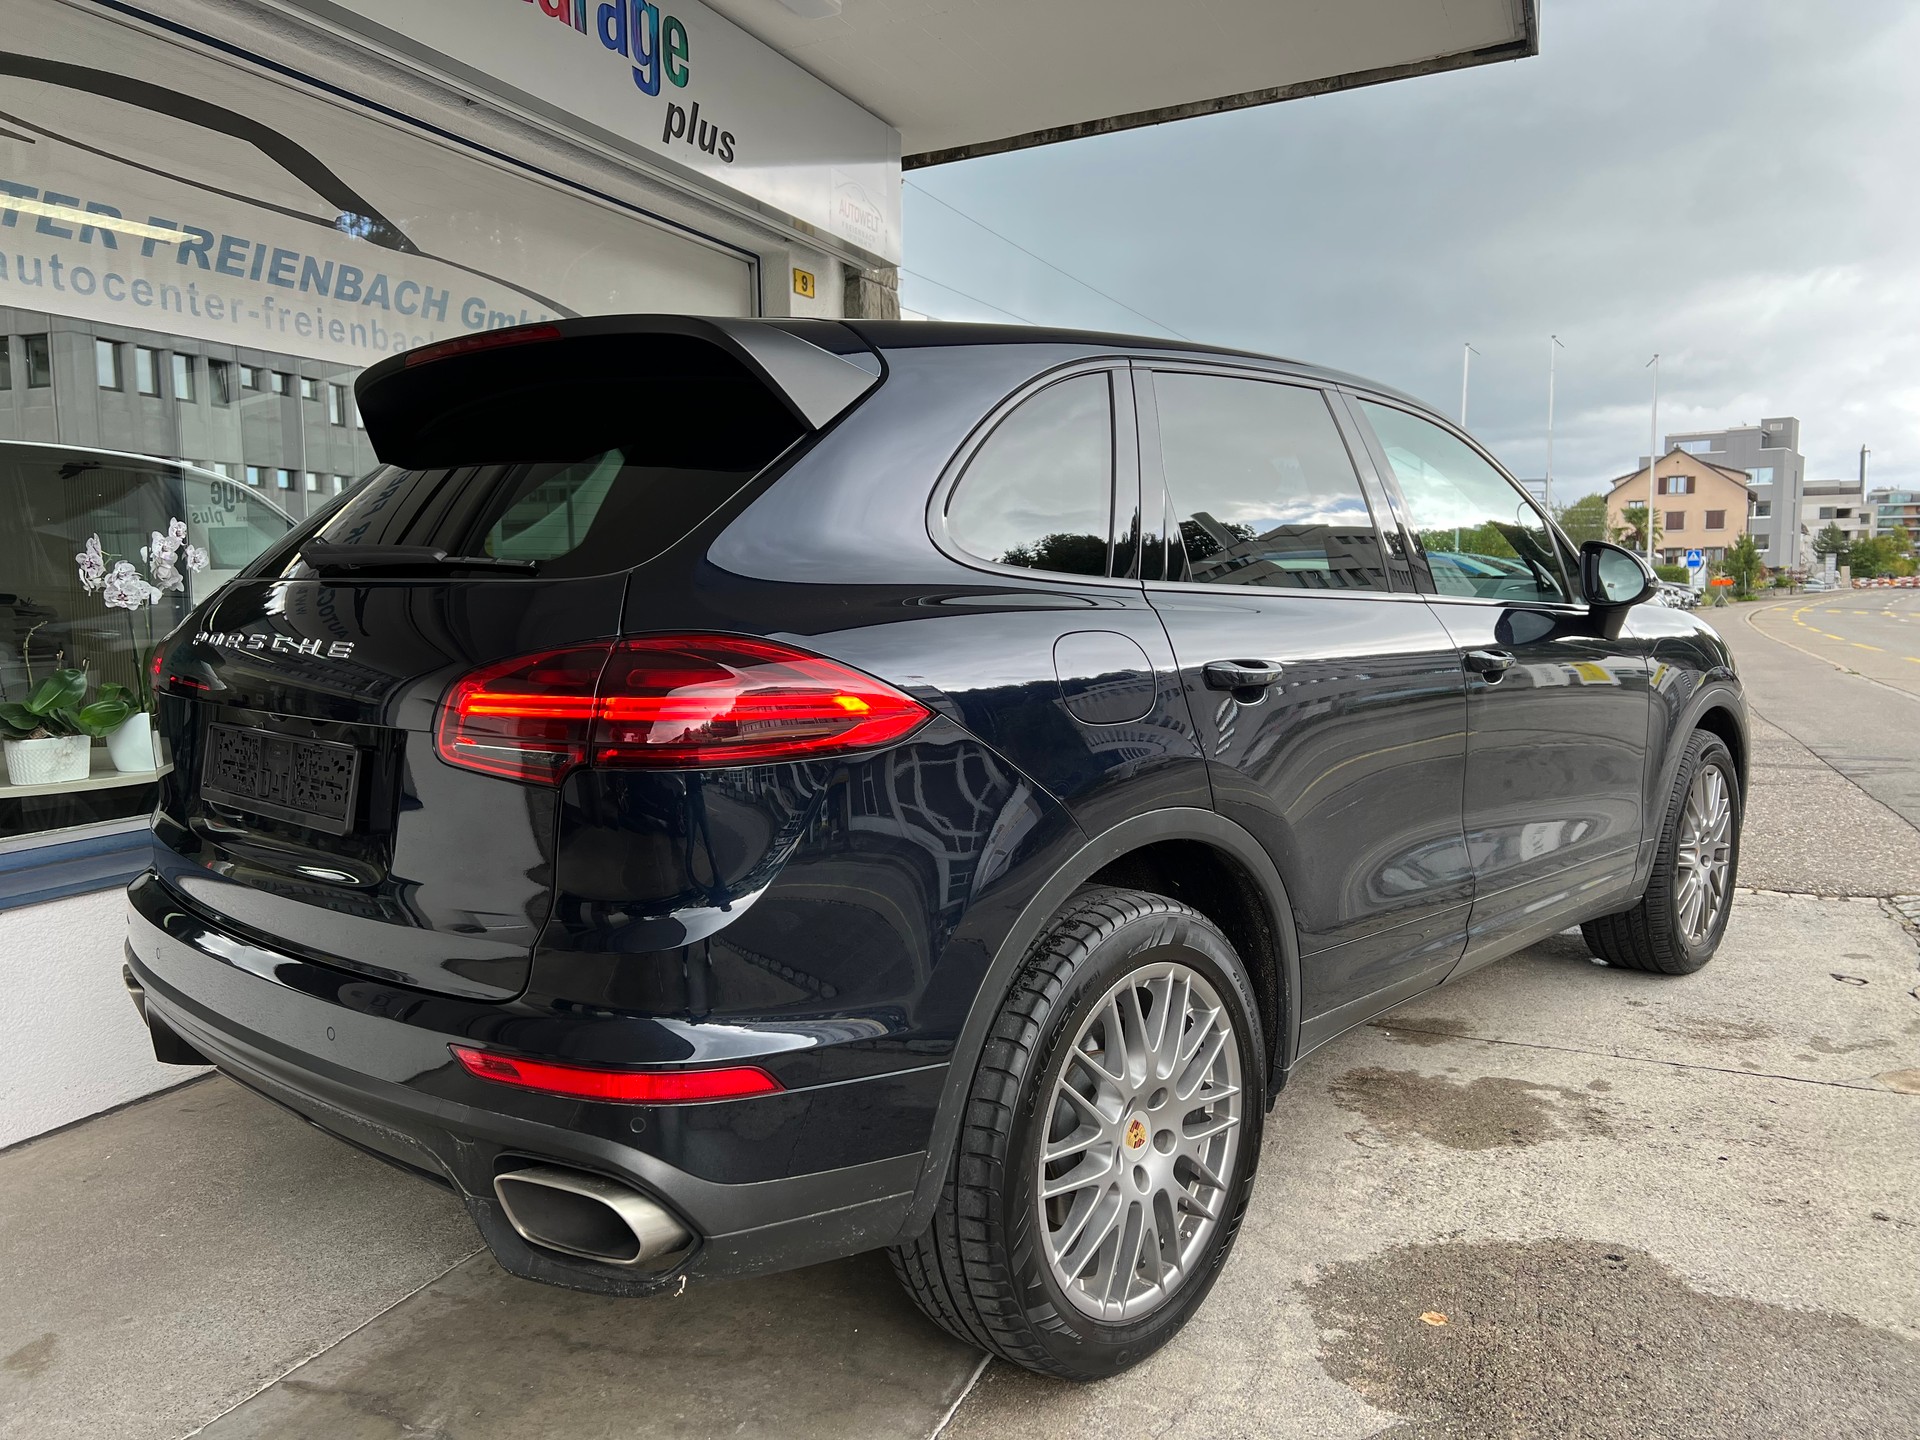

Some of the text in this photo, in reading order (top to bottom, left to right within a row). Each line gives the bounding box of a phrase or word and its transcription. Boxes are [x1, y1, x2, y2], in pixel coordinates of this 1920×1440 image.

[662, 101, 736, 164] plus
[838, 198, 880, 233] AUTOWELT
[140, 215, 450, 322] FREIENBACH
[801, 274, 808, 292] 9
[193, 631, 355, 659] PORSCHE
